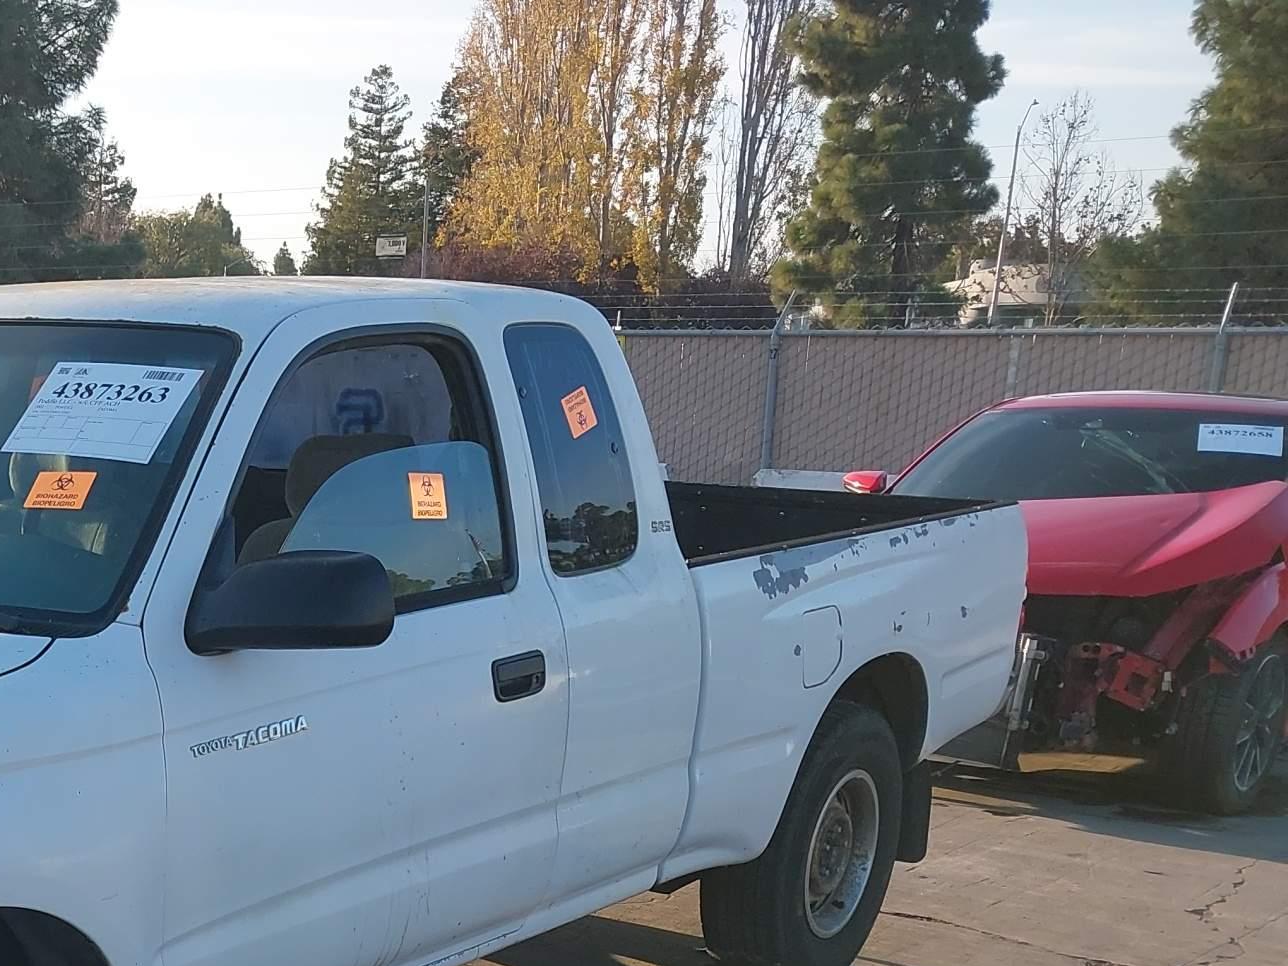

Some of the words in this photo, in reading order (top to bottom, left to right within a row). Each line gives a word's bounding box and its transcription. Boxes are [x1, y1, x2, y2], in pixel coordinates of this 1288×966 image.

[52, 381, 170, 404] 43873263
[1208, 429, 1273, 438] 43872658
[190, 736, 234, 758] TOYOTA
[232, 714, 309, 751] TACOMA
